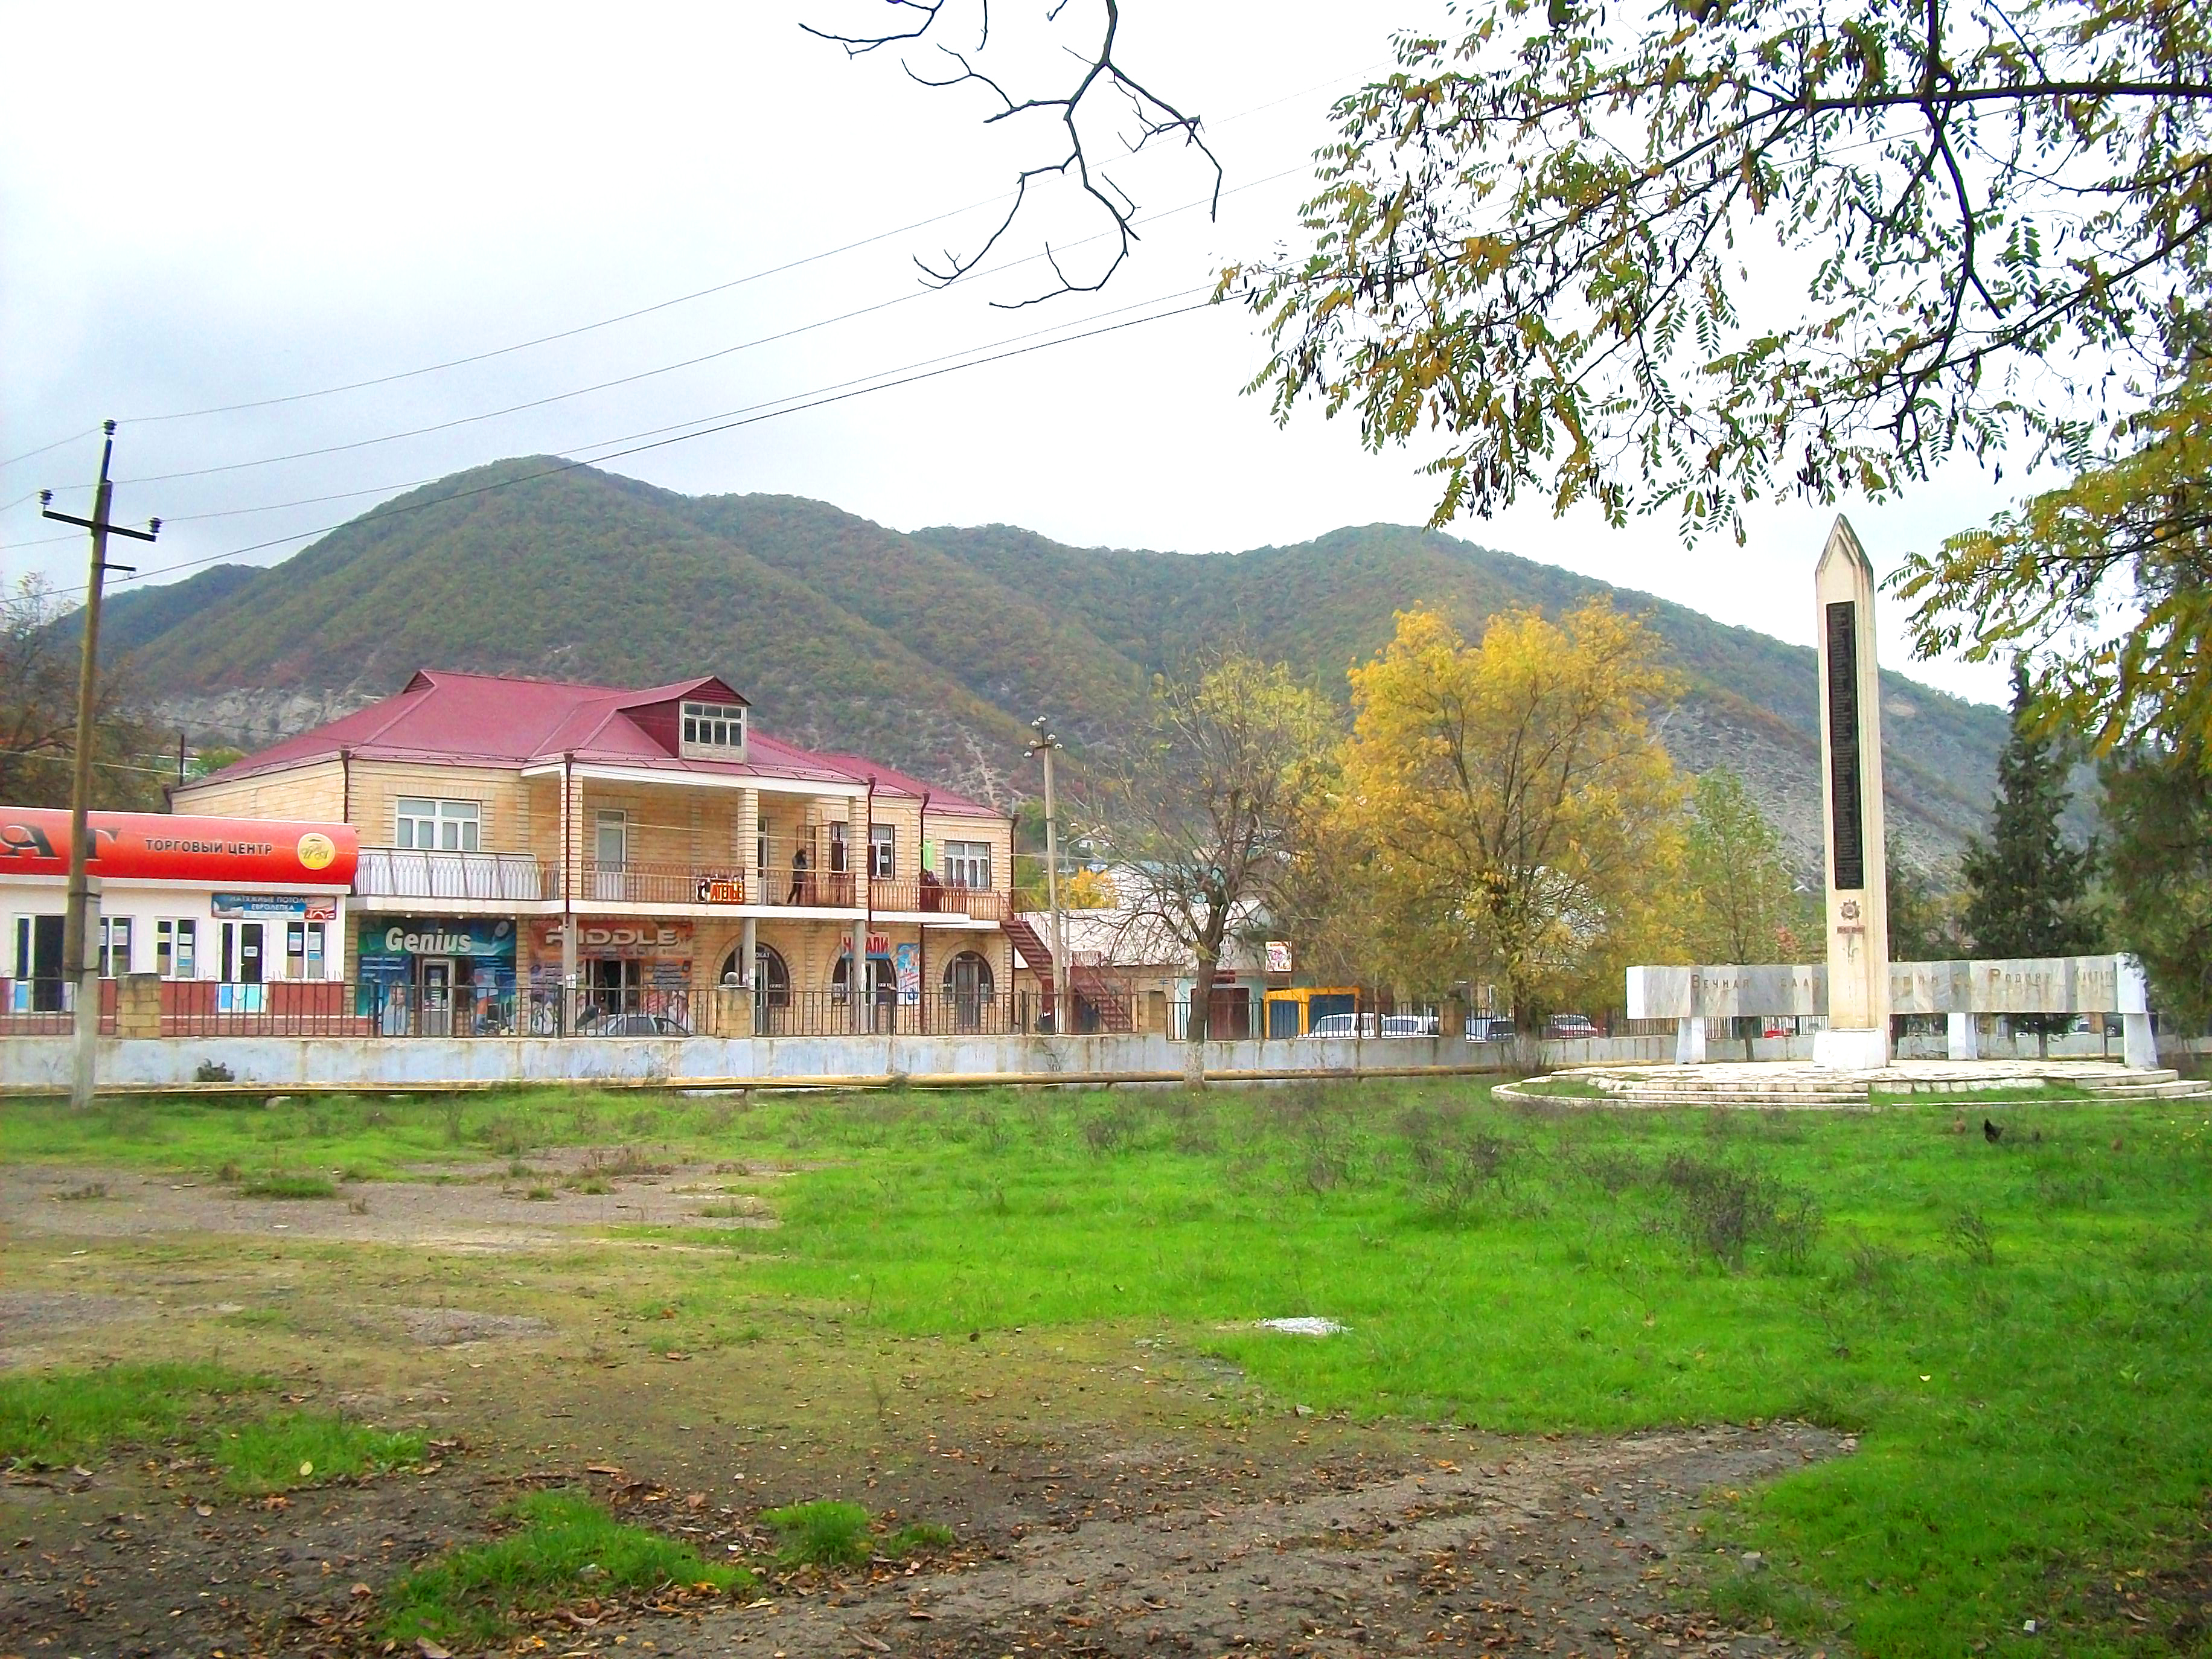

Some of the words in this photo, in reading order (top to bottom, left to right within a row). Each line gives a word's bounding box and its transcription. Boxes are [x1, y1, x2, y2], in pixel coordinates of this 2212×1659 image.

[145, 839, 223, 854] ТОРГОВЫЙ
[228, 842, 272, 857] ЦЕНТР
[711, 883, 743, 901] АТЕЛЬЕ
[386, 927, 472, 952] Genius
[843, 936, 890, 954] НАЛИ
